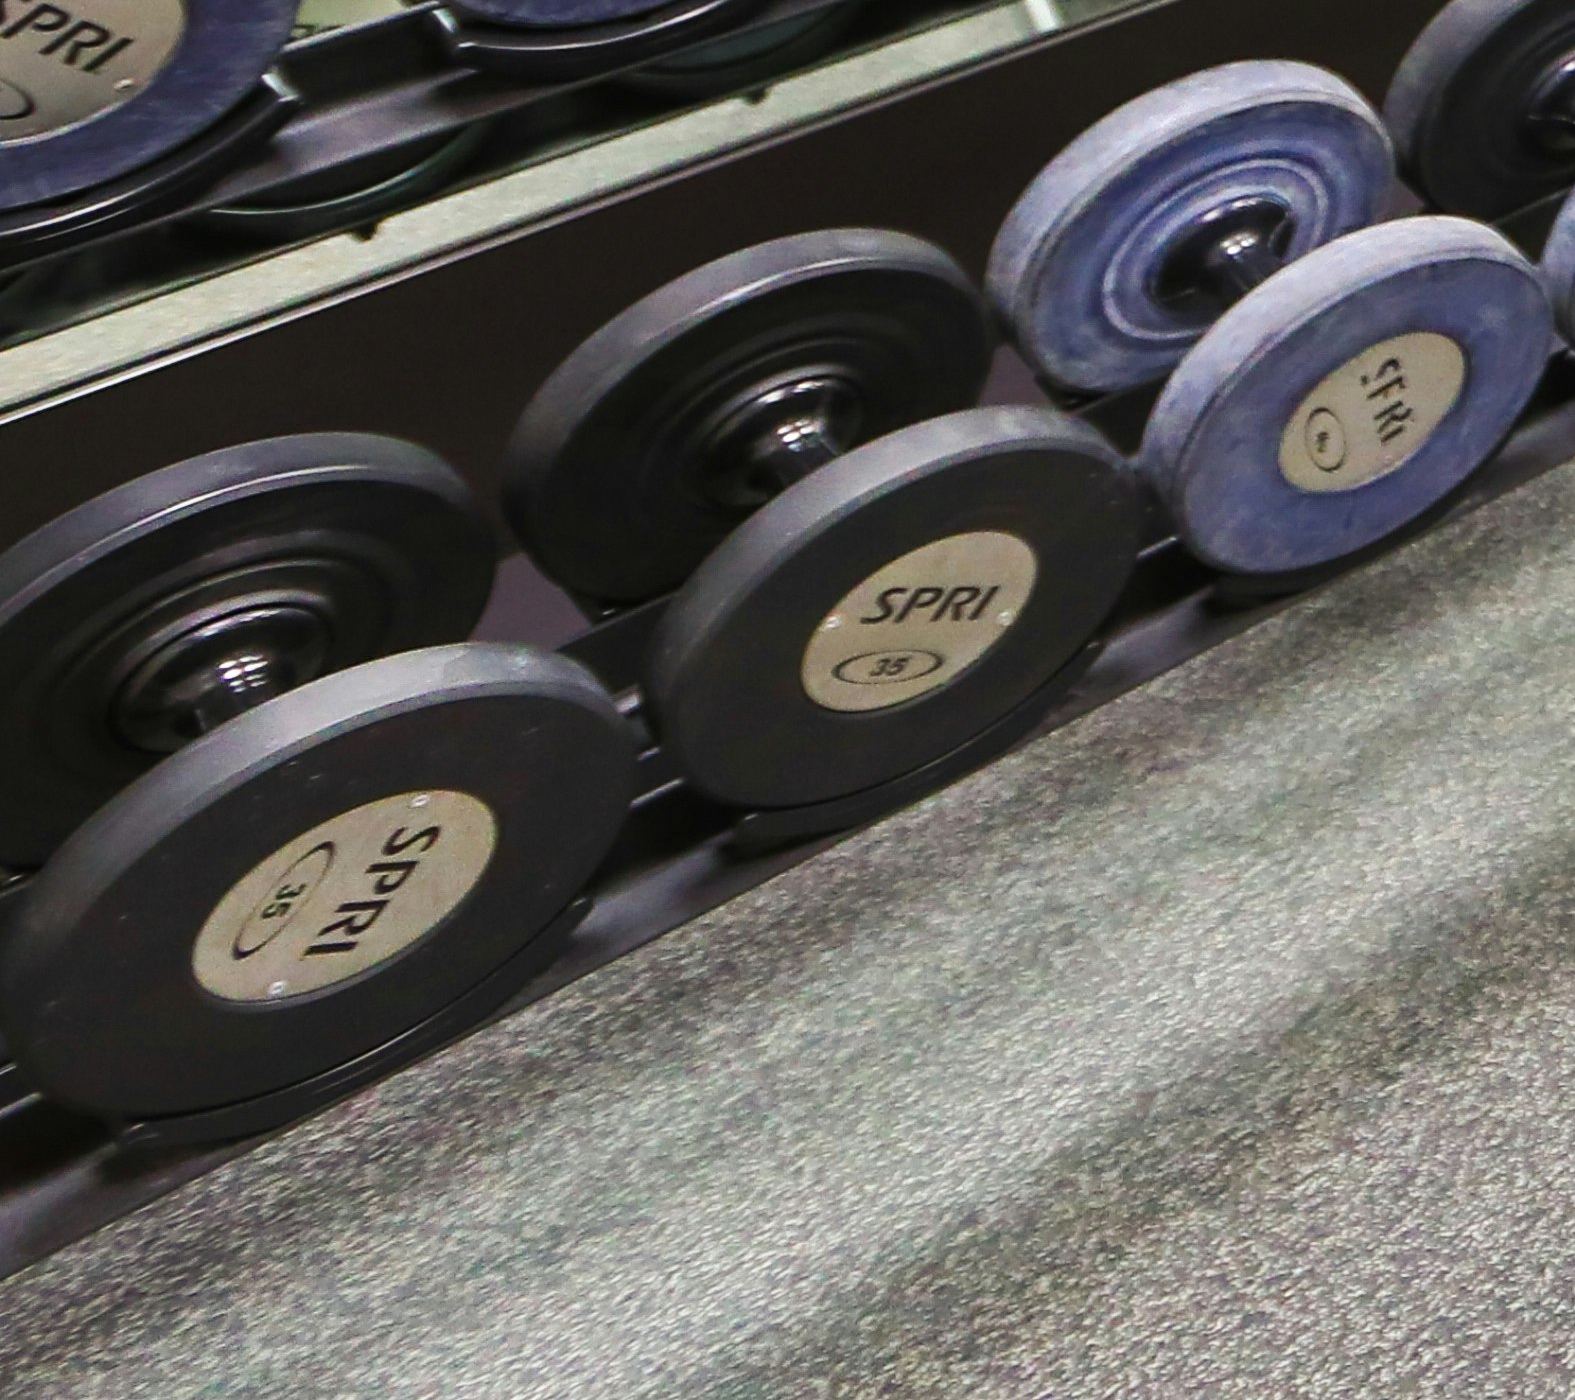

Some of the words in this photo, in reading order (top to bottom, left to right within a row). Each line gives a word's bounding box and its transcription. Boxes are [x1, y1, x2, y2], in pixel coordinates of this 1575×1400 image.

[859, 585, 1000, 625] SPRI
[869, 657, 911, 677] 35
[262, 883, 307, 919] 35
[303, 825, 441, 956] SPRI
